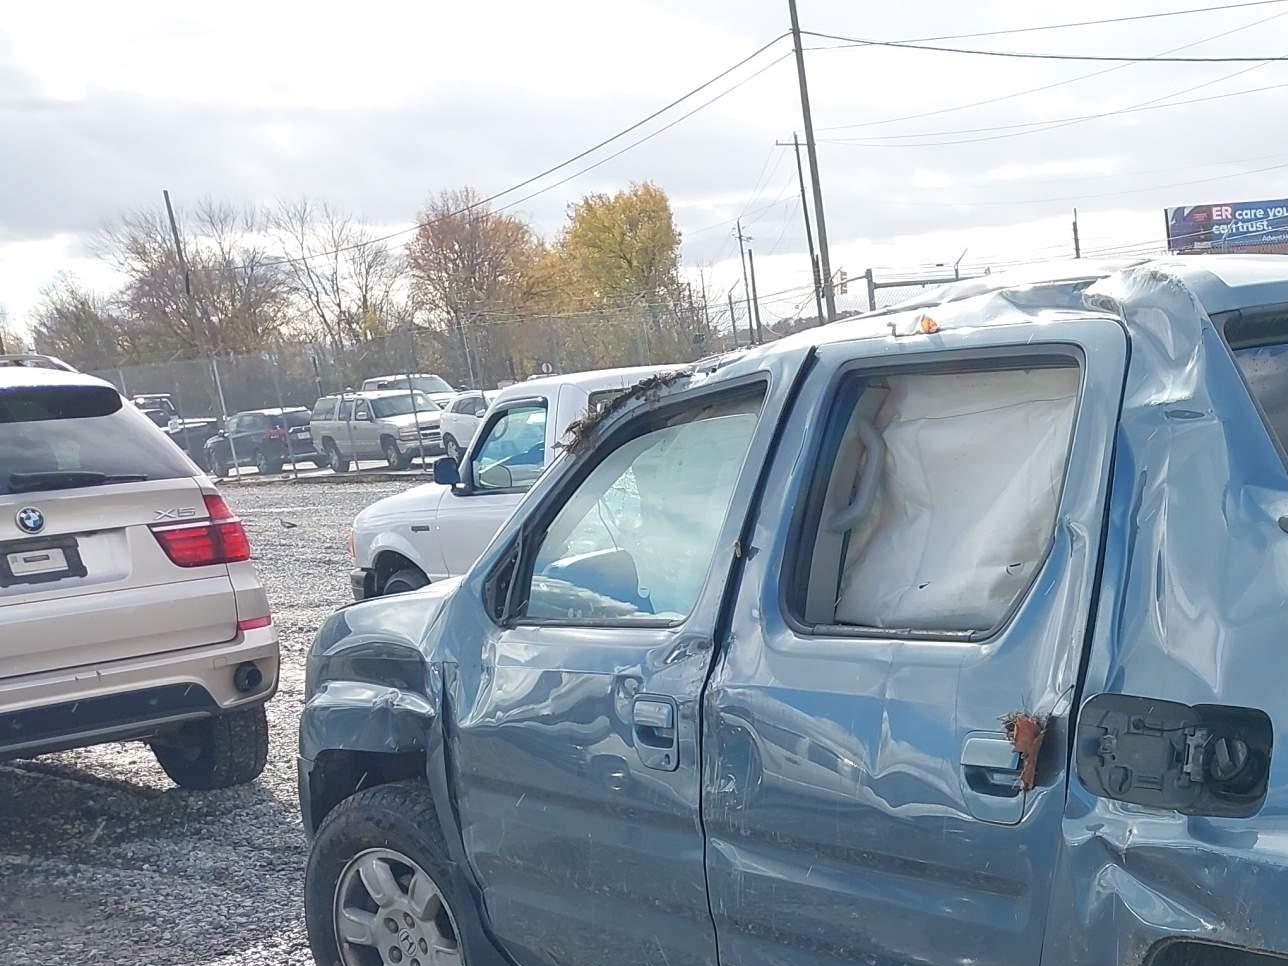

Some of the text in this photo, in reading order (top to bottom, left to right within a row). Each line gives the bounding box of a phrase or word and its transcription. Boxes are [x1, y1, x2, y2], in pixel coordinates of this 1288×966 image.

[1212, 206, 1233, 220] ER
[1235, 208, 1265, 219] care
[1212, 221, 1272, 234] can trust.
[153, 506, 196, 520] X5
